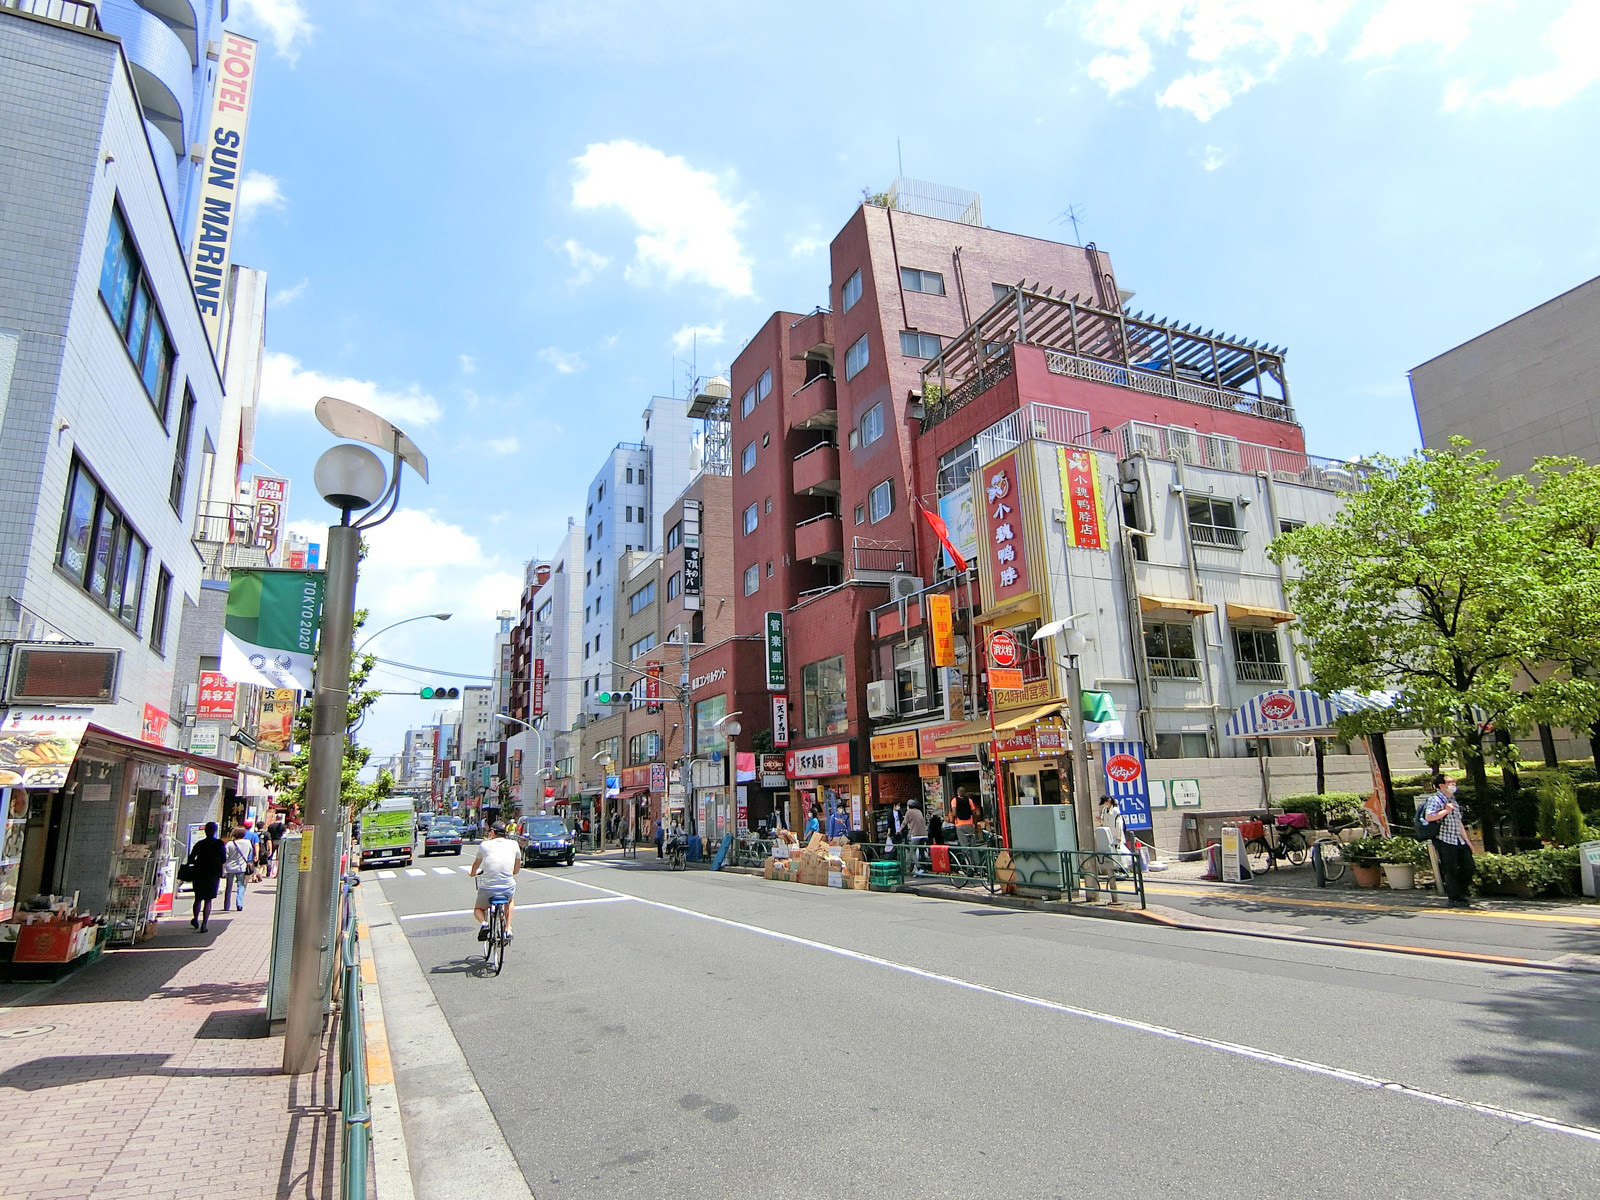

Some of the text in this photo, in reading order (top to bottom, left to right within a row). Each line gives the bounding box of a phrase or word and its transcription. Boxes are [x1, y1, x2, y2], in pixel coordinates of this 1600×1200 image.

[193, 37, 253, 317] HOTEL SUN MARINE
[258, 489, 283, 500] OPEN
[261, 480, 280, 491] 24h
[1073, 474, 1094, 536] 小魏鴨脖店
[992, 502, 1018, 588] 小魏鴨脖
[299, 581, 317, 650] TOKYO 2020
[769, 618, 782, 664] 管楽器
[992, 643, 1013, 656] 消火栓
[201, 689, 235, 702] 美容室
[264, 687, 275, 712] 火鍋
[997, 682, 1049, 705] 24時間営業
